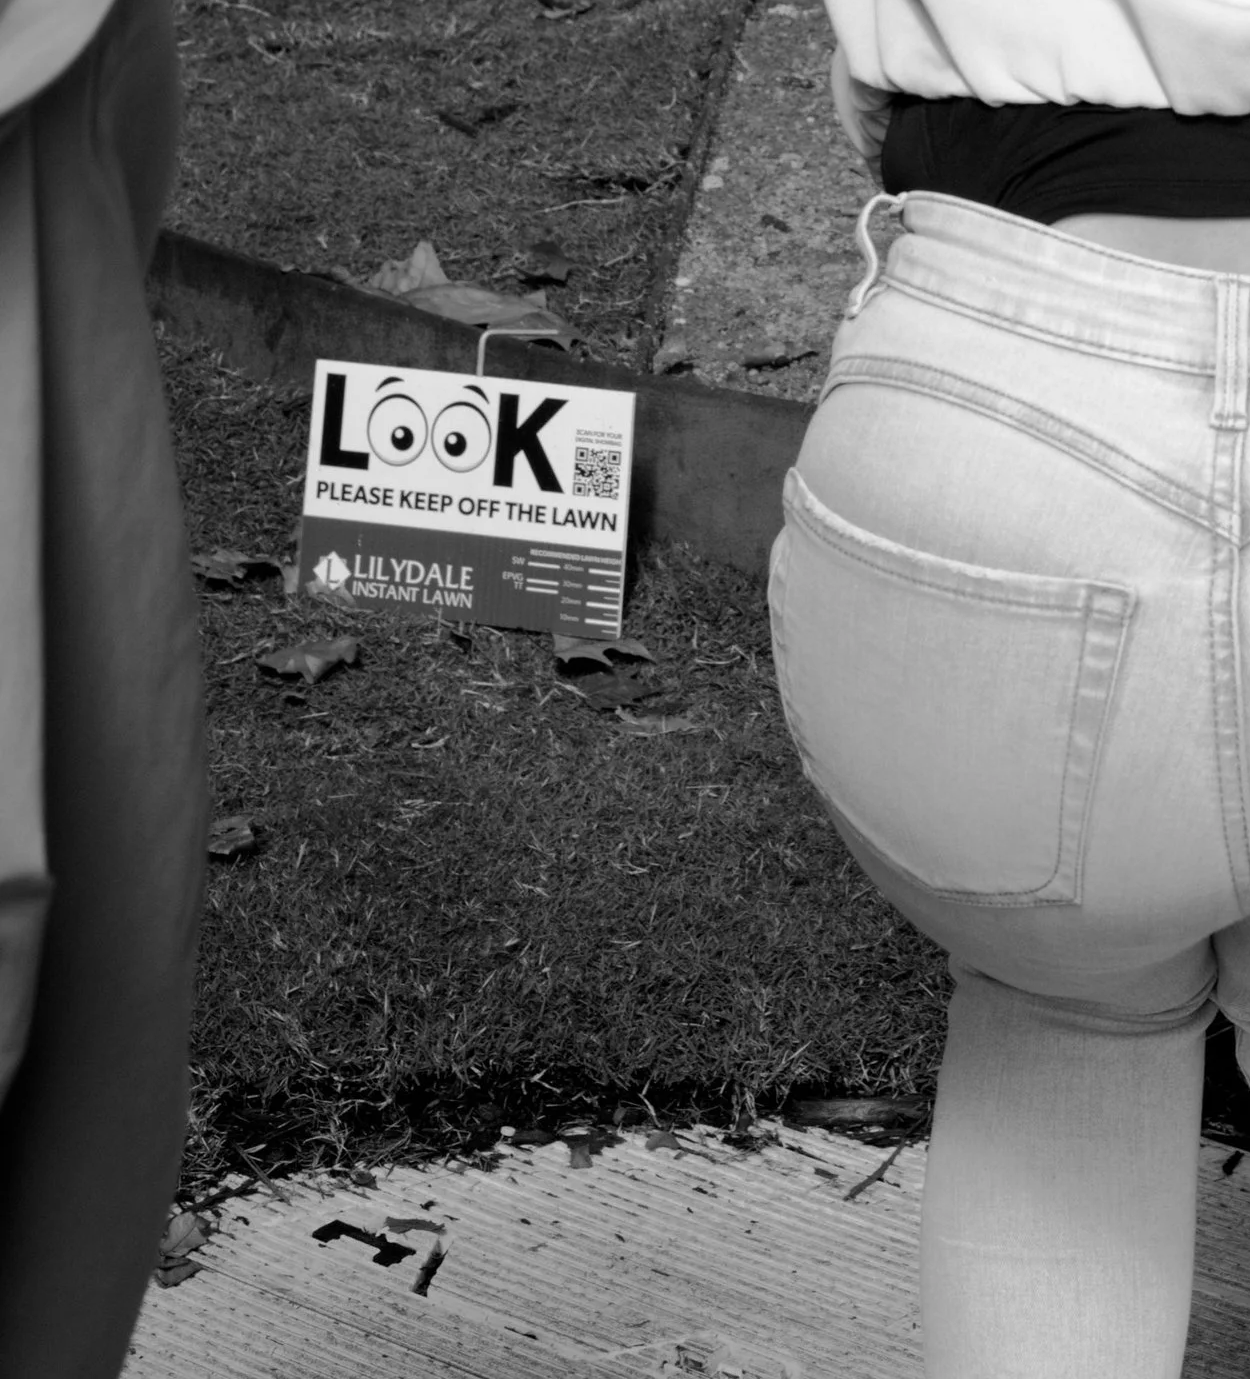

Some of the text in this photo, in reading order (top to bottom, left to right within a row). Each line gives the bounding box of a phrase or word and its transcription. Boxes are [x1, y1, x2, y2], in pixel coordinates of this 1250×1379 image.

[319, 372, 569, 494] LOOK
[316, 481, 618, 532] PLEASE KEEP OFF THE LAWN
[512, 556, 525, 566] SW
[354, 554, 474, 590] LILYDALE
[352, 580, 472, 609] INSTANT LAWN
[514, 581, 523, 590] TT
[561, 596, 581, 606] 20mm
[559, 613, 579, 622] 10mm
